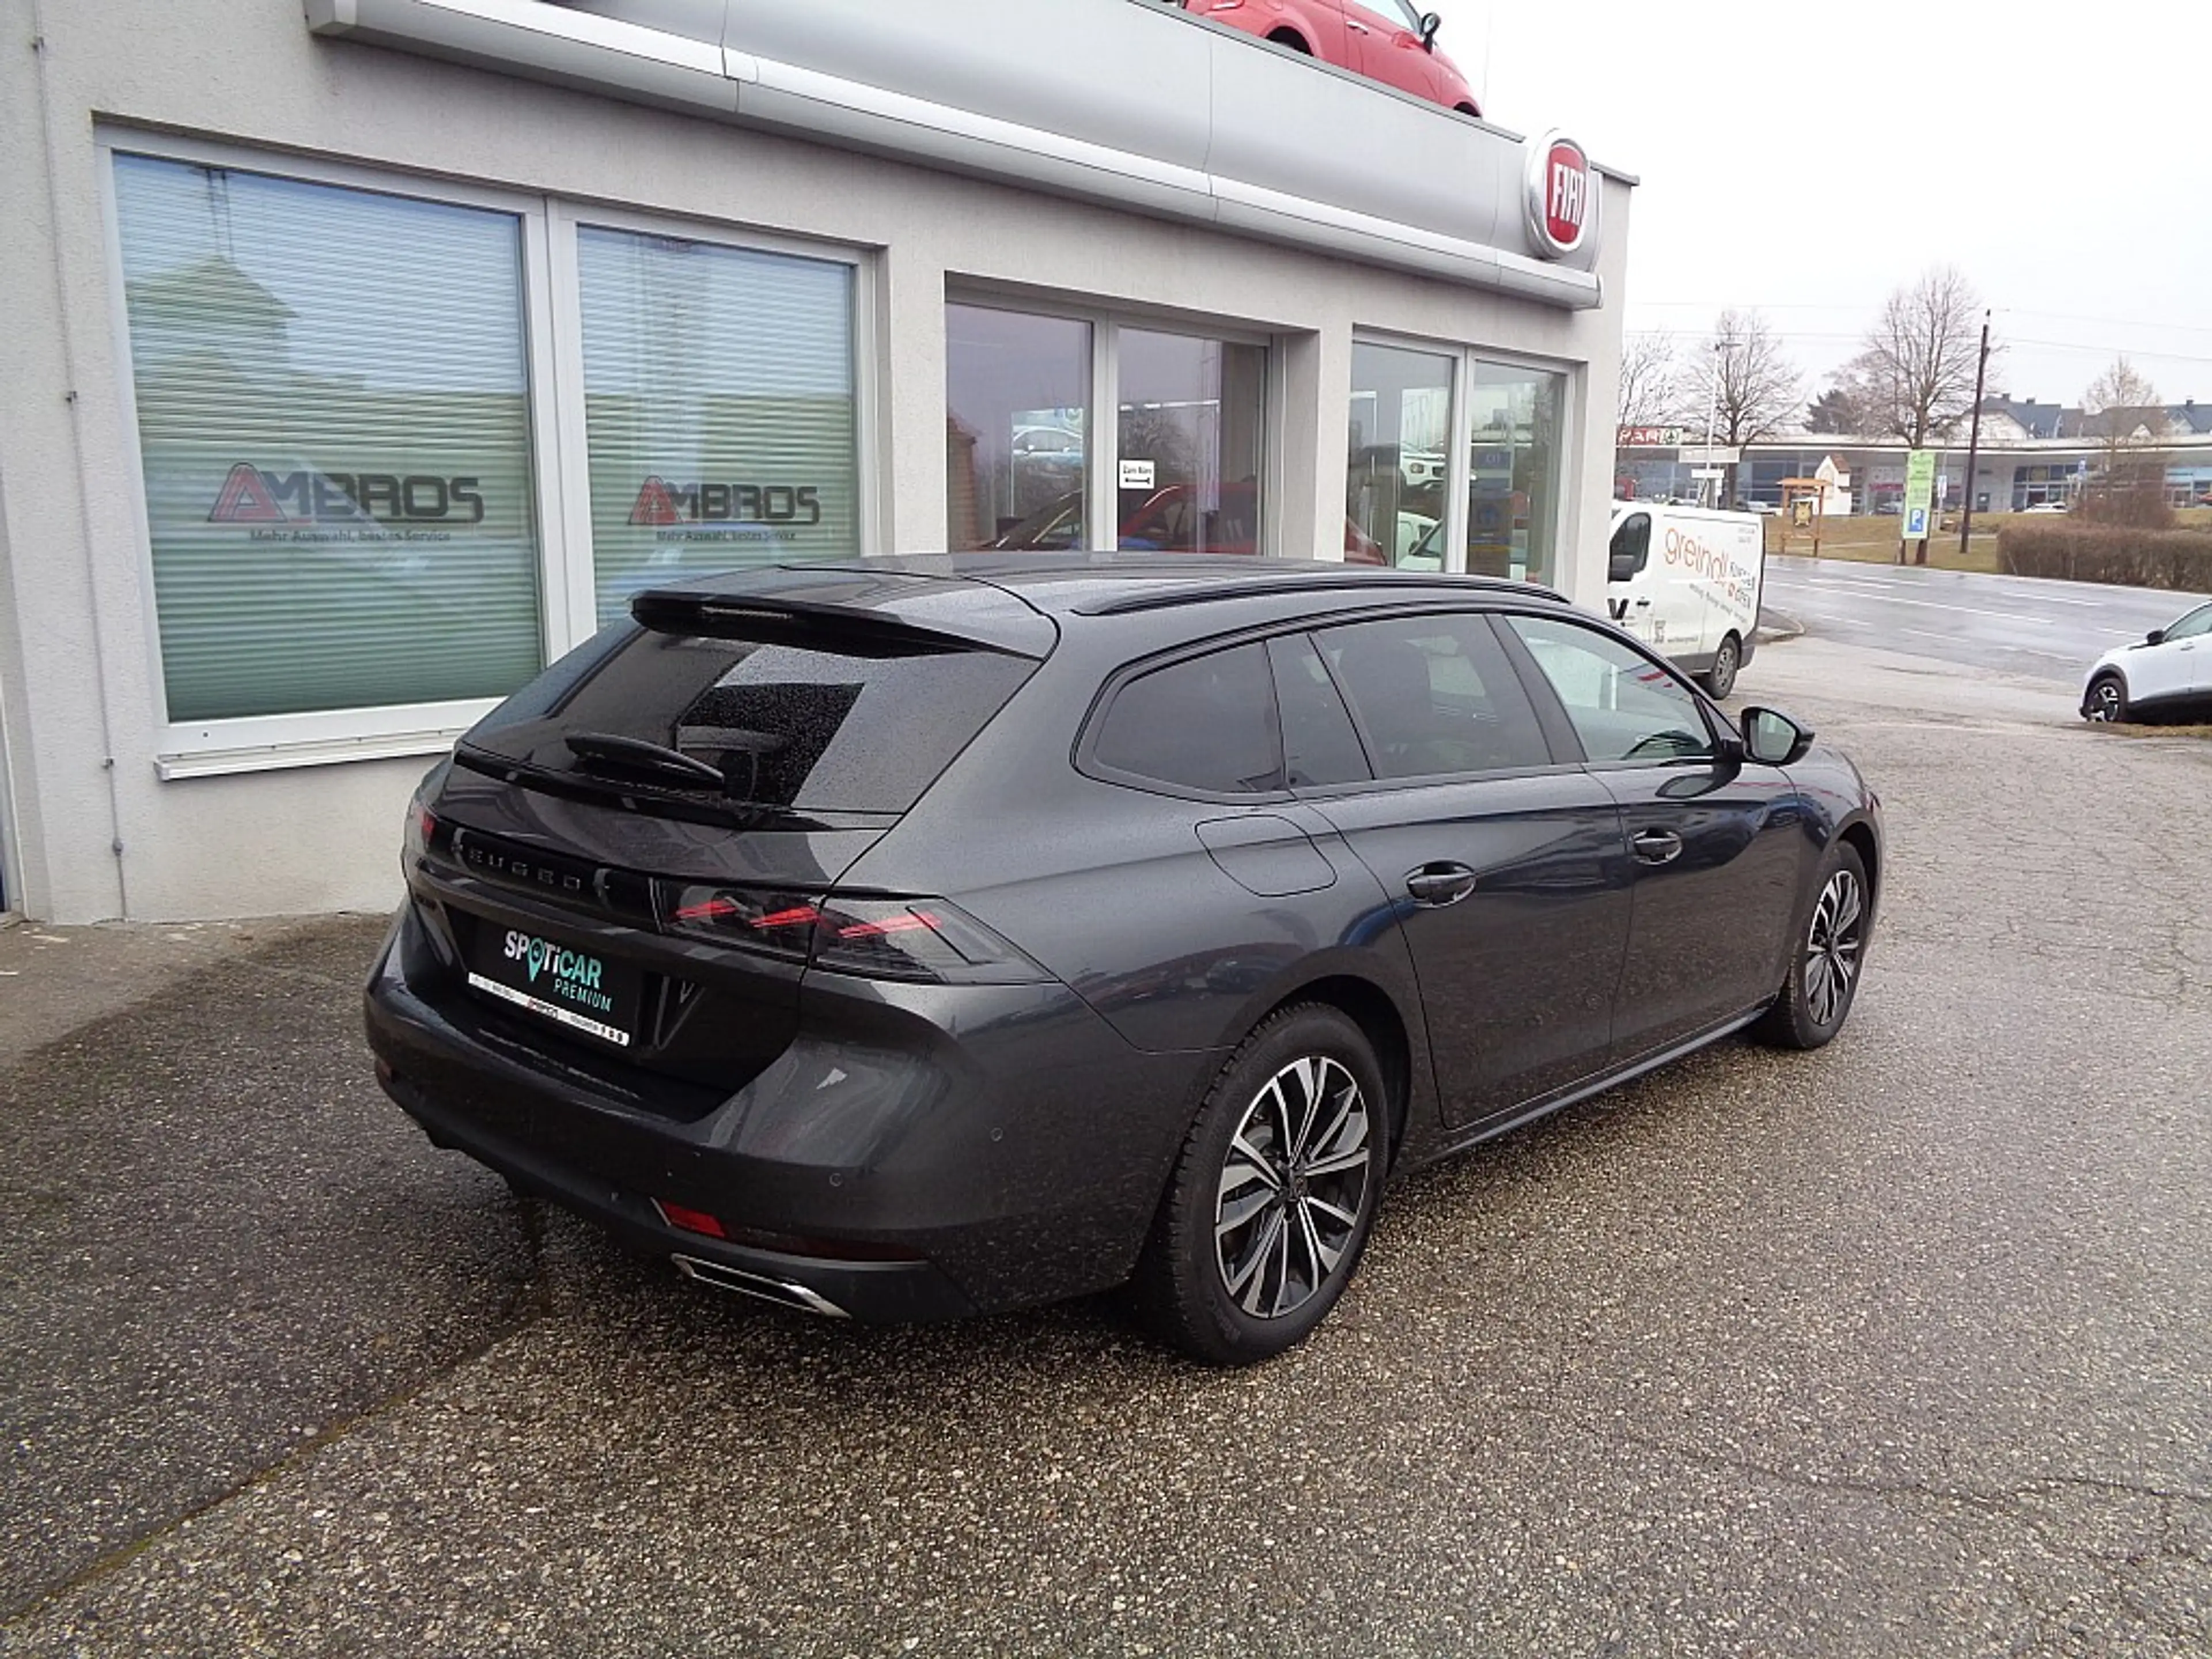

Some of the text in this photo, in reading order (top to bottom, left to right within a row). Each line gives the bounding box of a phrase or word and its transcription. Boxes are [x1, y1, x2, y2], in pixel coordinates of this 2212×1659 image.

[1551, 162, 1584, 225] FIAT
[207, 461, 484, 523] AMBROS
[628, 475, 820, 525] AMBROS
[249, 529, 287, 542] Mehr
[404, 529, 451, 542] Service
[554, 979, 612, 1012] PREMIUM
